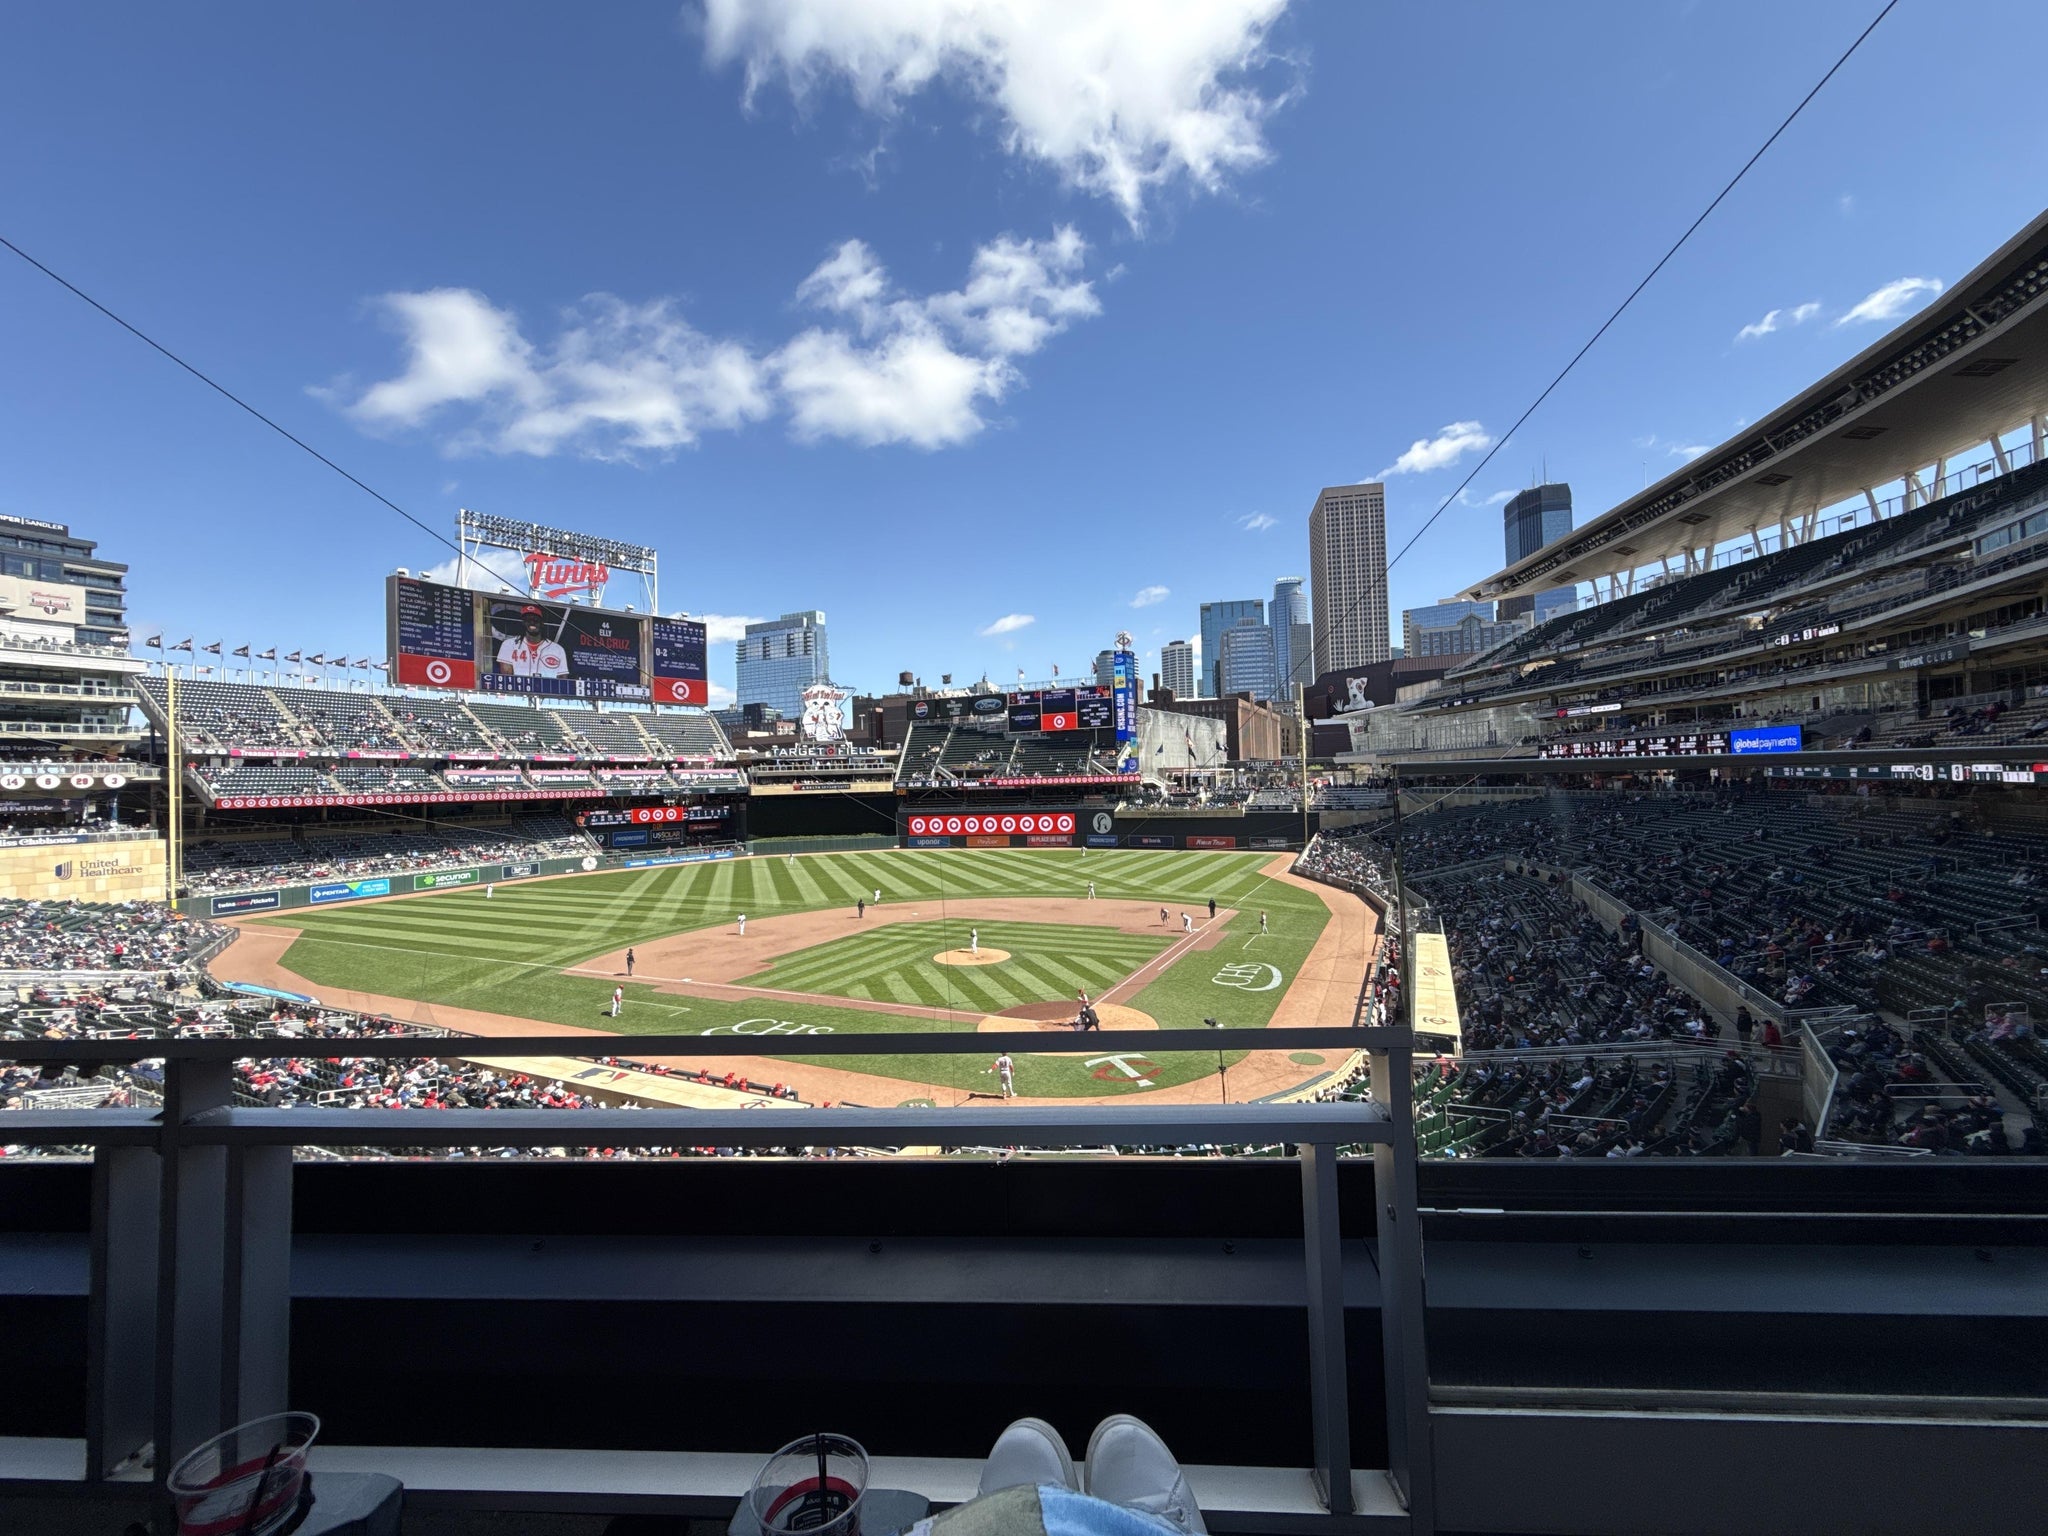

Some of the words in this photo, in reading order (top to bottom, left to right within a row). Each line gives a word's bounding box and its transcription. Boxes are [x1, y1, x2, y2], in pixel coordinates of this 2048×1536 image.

[25, 520, 64, 530] SANDLER
[524, 553, 609, 590] Twins
[600, 628, 612, 637] ELLY
[1805, 630, 1810, 640] 3
[580, 634, 592, 646] DE
[593, 636, 604, 648] LA
[606, 638, 630, 650] CRUZ
[512, 650, 528, 662] 44
[656, 648, 668, 657] 0-2
[1898, 656, 1924, 669] thrivent
[1926, 650, 1953, 664] CLUB
[1117, 693, 1125, 731] CHSINC.COM
[772, 747, 824, 756] TARGET
[838, 747, 876, 755] FIELD
[1925, 766, 1931, 778] 2
[1955, 766, 1960, 779] 3
[7, 778, 18, 786] 14
[80, 859, 119, 869] United
[80, 866, 143, 878] Healthcare
[435, 872, 471, 882] securian
[322, 888, 349, 896] PENTAIR
[218, 897, 275, 908] twins.com/tickets
[1212, 962, 1264, 986] CHS
